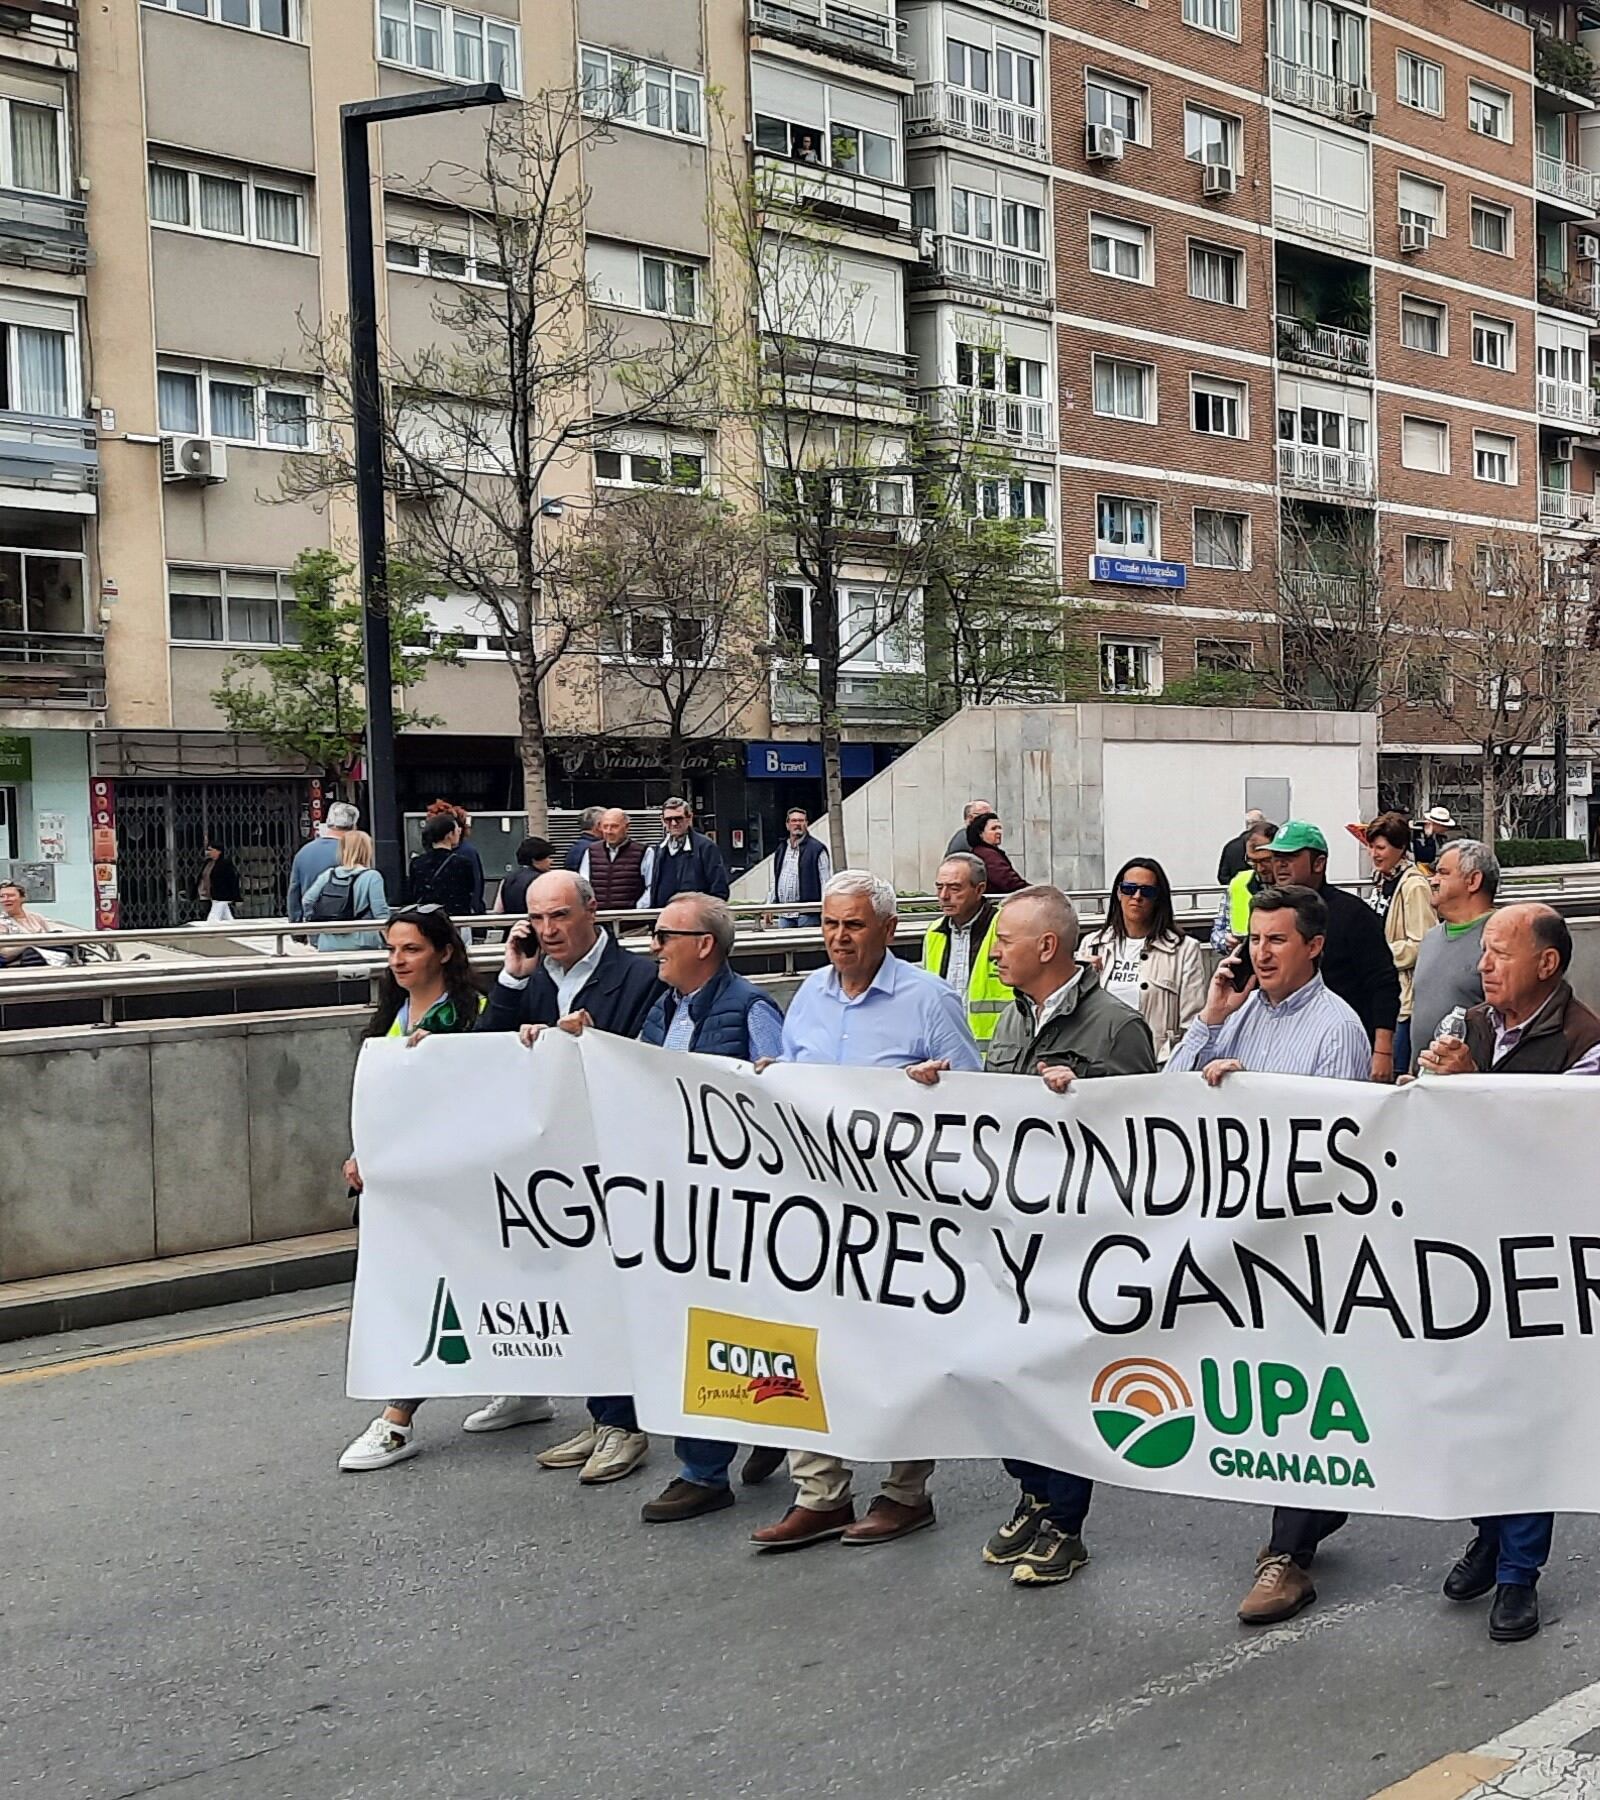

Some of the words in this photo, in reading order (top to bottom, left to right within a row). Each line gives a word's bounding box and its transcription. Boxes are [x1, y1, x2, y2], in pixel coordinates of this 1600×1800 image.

[766, 750, 779, 772] B
[674, 1077, 784, 1175] LOS
[780, 1101, 1405, 1219] IMPRESCINDIBLES:
[494, 1165, 967, 1315] AGCULTORES
[991, 1227, 1044, 1324] Y
[477, 1302, 573, 1340] ASAJA
[492, 1342, 563, 1358] GRANADA
[709, 1341, 797, 1379] COAG
[697, 1384, 749, 1408] Granada
[1200, 1357, 1371, 1444] UPA
[1209, 1447, 1376, 1489] GRANADA
